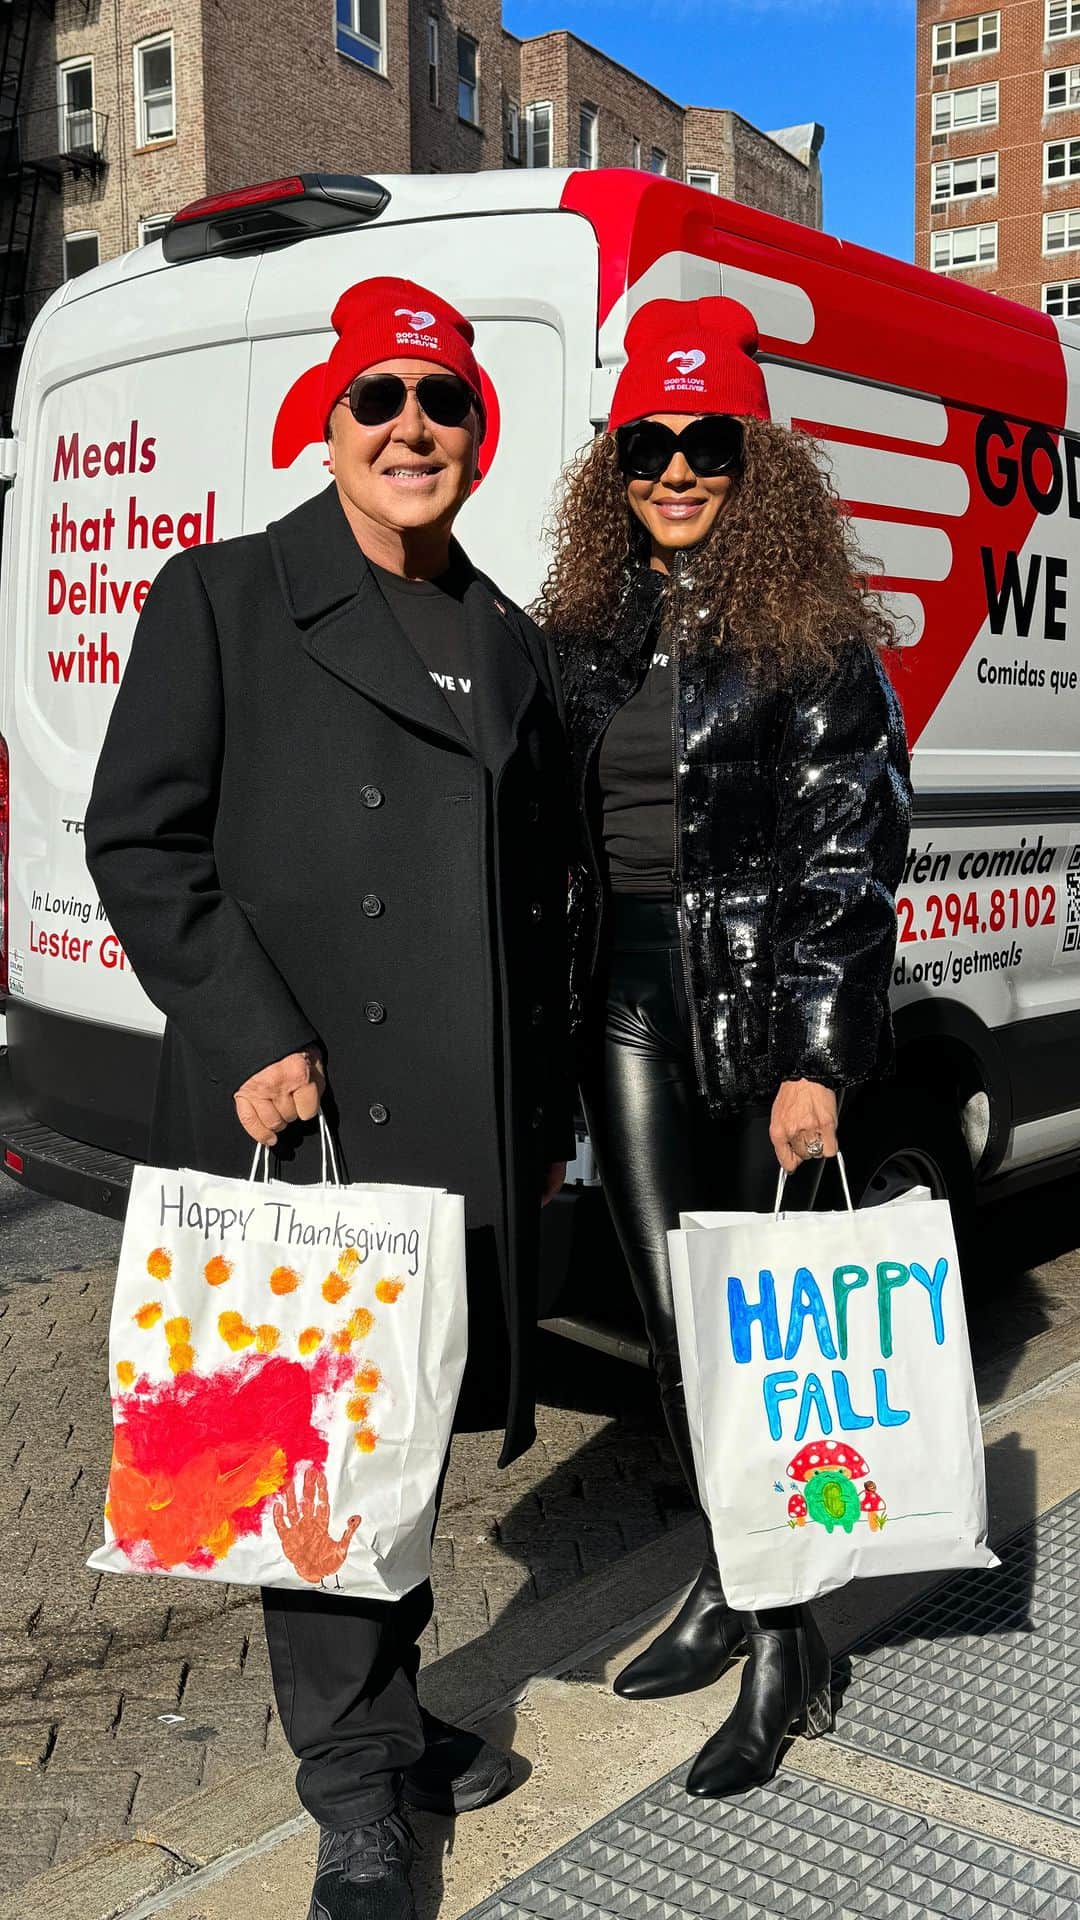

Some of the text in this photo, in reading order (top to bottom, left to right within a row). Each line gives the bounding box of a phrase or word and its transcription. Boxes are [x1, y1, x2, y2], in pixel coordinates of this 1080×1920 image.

[420, 334, 438, 343] LOVE
[664, 384, 676, 392] WE
[687, 377, 705, 386] LOVE
[53, 420, 156, 482] Meals
[50, 502, 115, 554] that
[980, 546, 1067, 641] WE
[48, 632, 120, 684] with
[977, 657, 1078, 695] Comidas que
[958, 835, 1056, 881] comida
[31, 890, 42, 911] In
[44, 893, 92, 924] Loving
[896, 885, 1056, 943] 2.294.8102
[29, 921, 93, 963] Lester
[159, 1184, 420, 1276] Happy Thanksgiving
[727, 1257, 948, 1364] HAPPY
[762, 1368, 911, 1442] FALL
